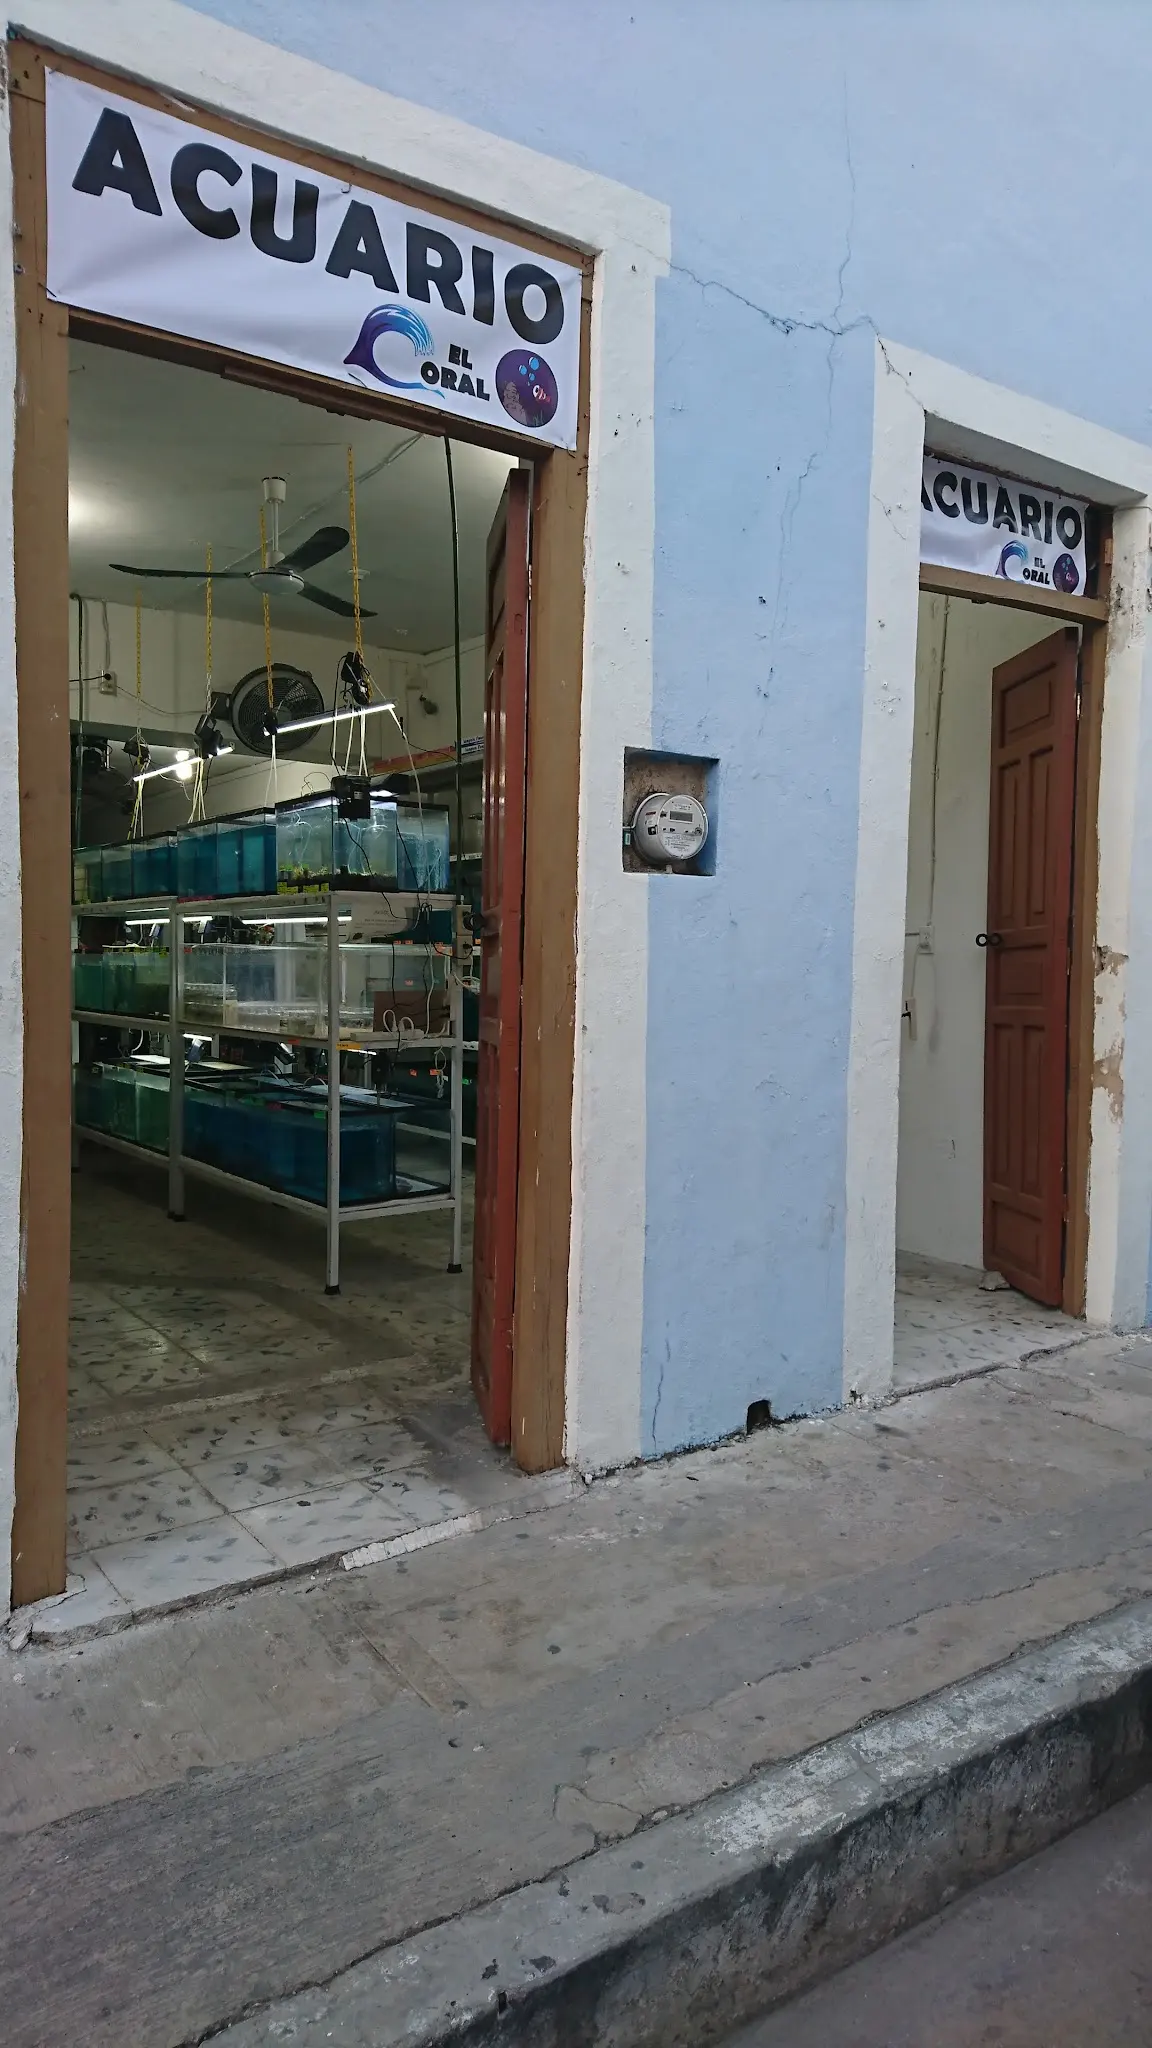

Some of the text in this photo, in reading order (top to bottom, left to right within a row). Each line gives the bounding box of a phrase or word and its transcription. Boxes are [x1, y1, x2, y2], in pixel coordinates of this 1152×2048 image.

[72, 107, 565, 344] ACUARIO
[448, 344, 473, 370] EL
[1034, 557, 1046, 569] EL
